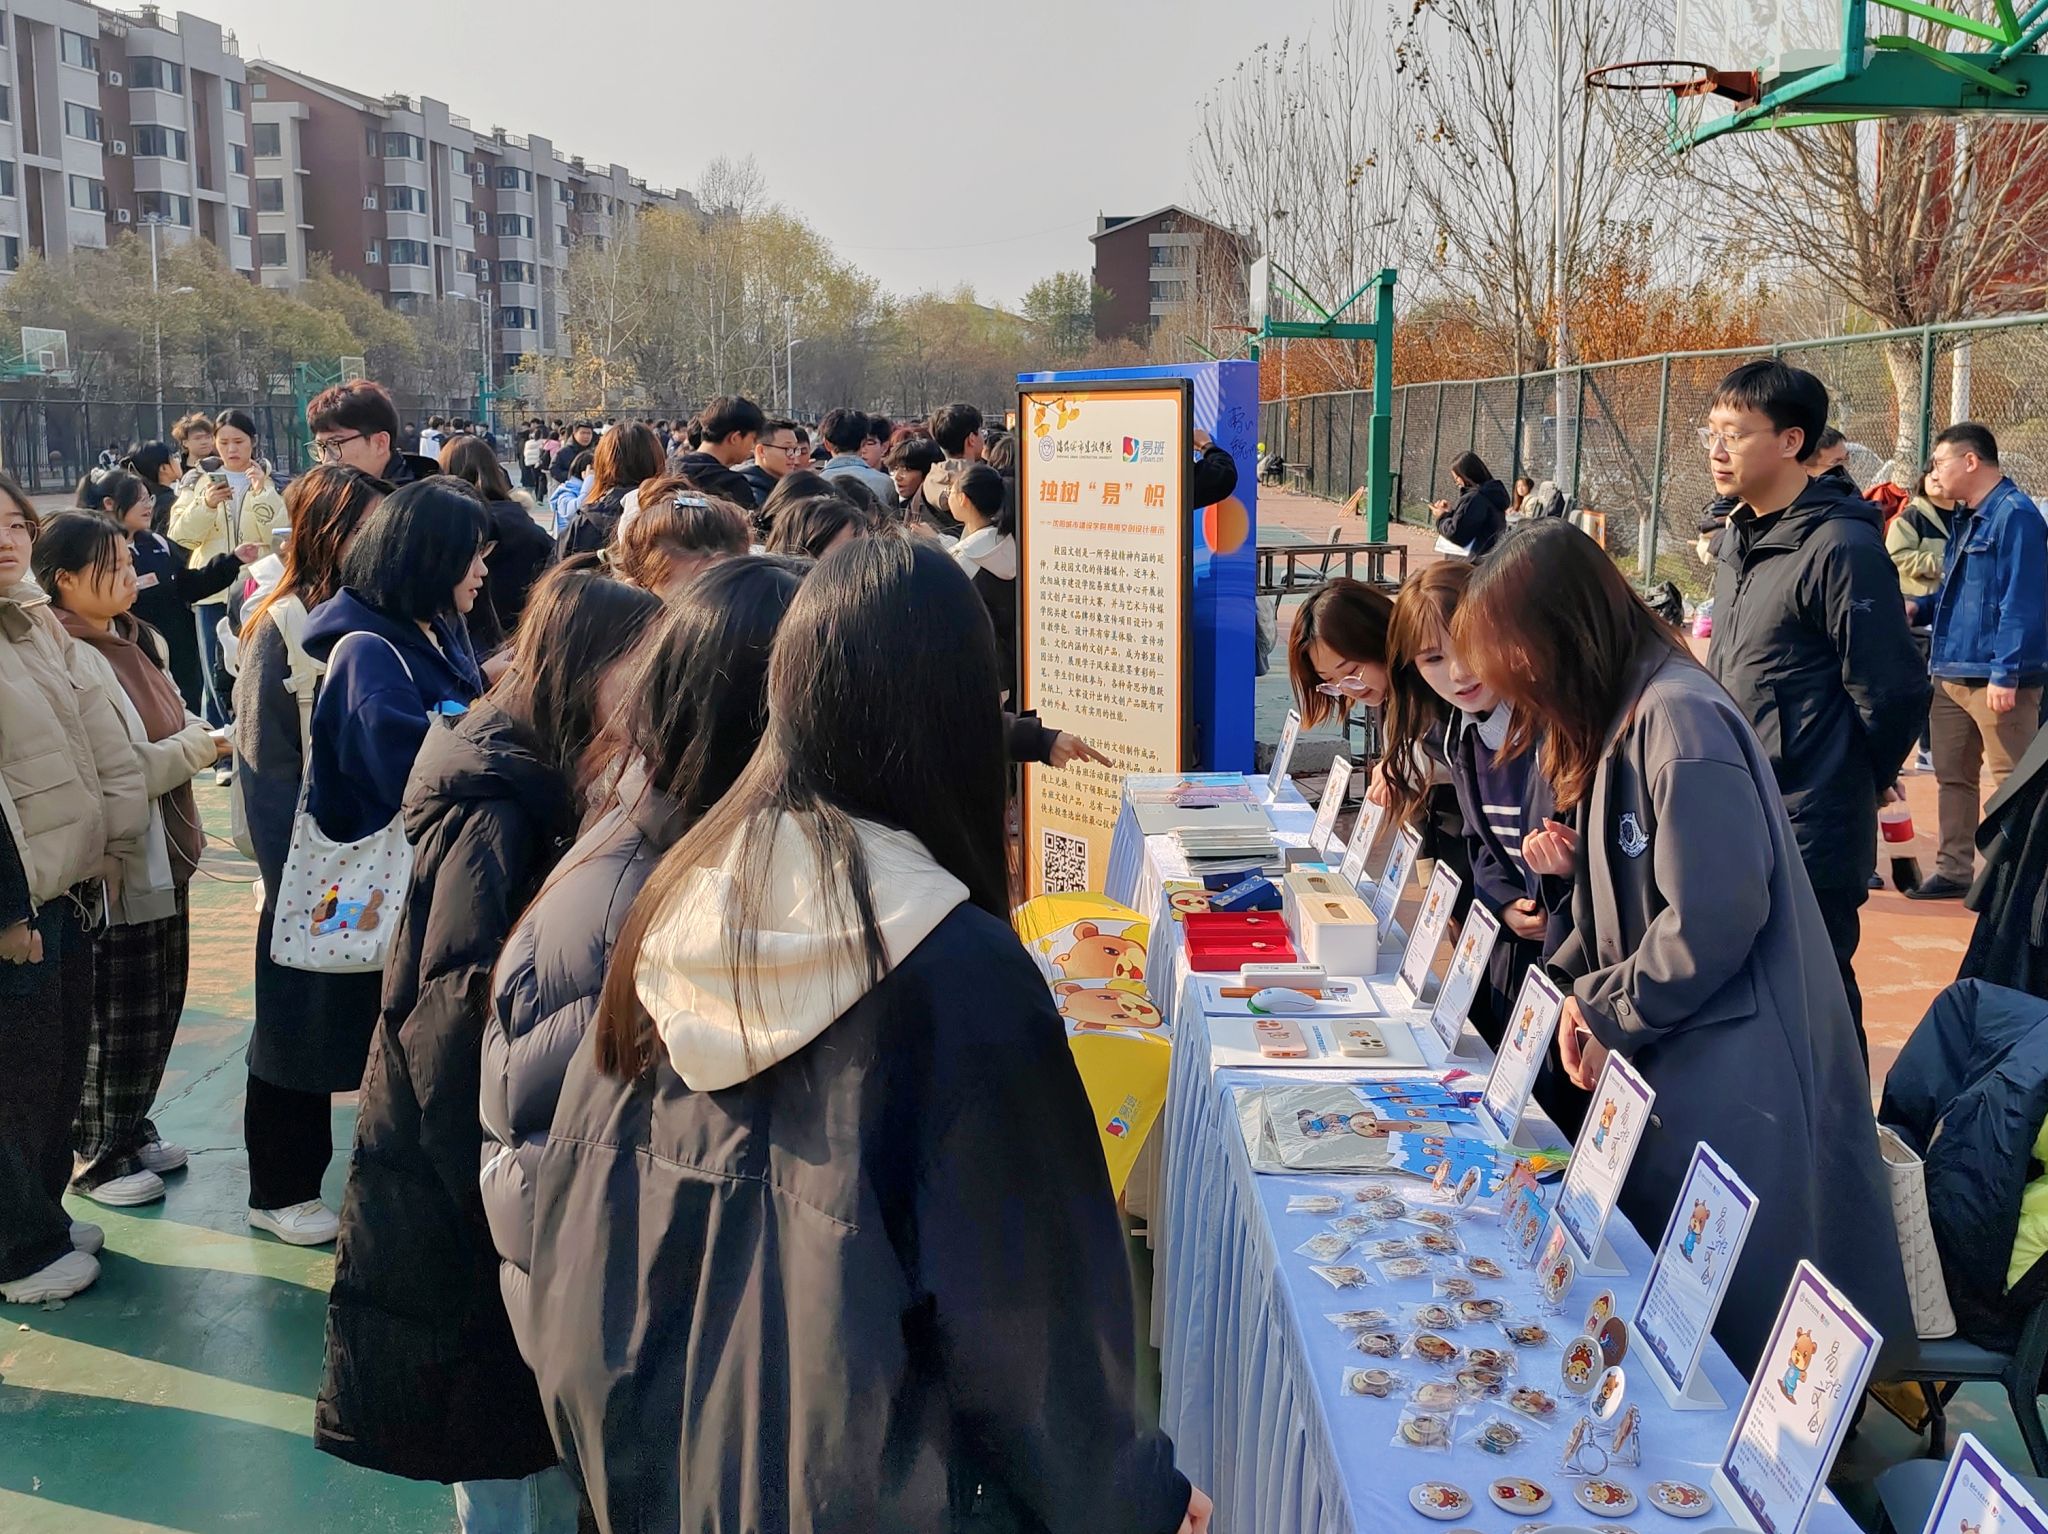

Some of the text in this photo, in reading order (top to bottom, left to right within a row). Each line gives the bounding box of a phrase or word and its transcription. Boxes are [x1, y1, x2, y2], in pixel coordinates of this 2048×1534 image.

[1141, 441, 1165, 455] 易班
[1054, 546, 1165, 564] 校园文创是一所学校精神内涵的延
